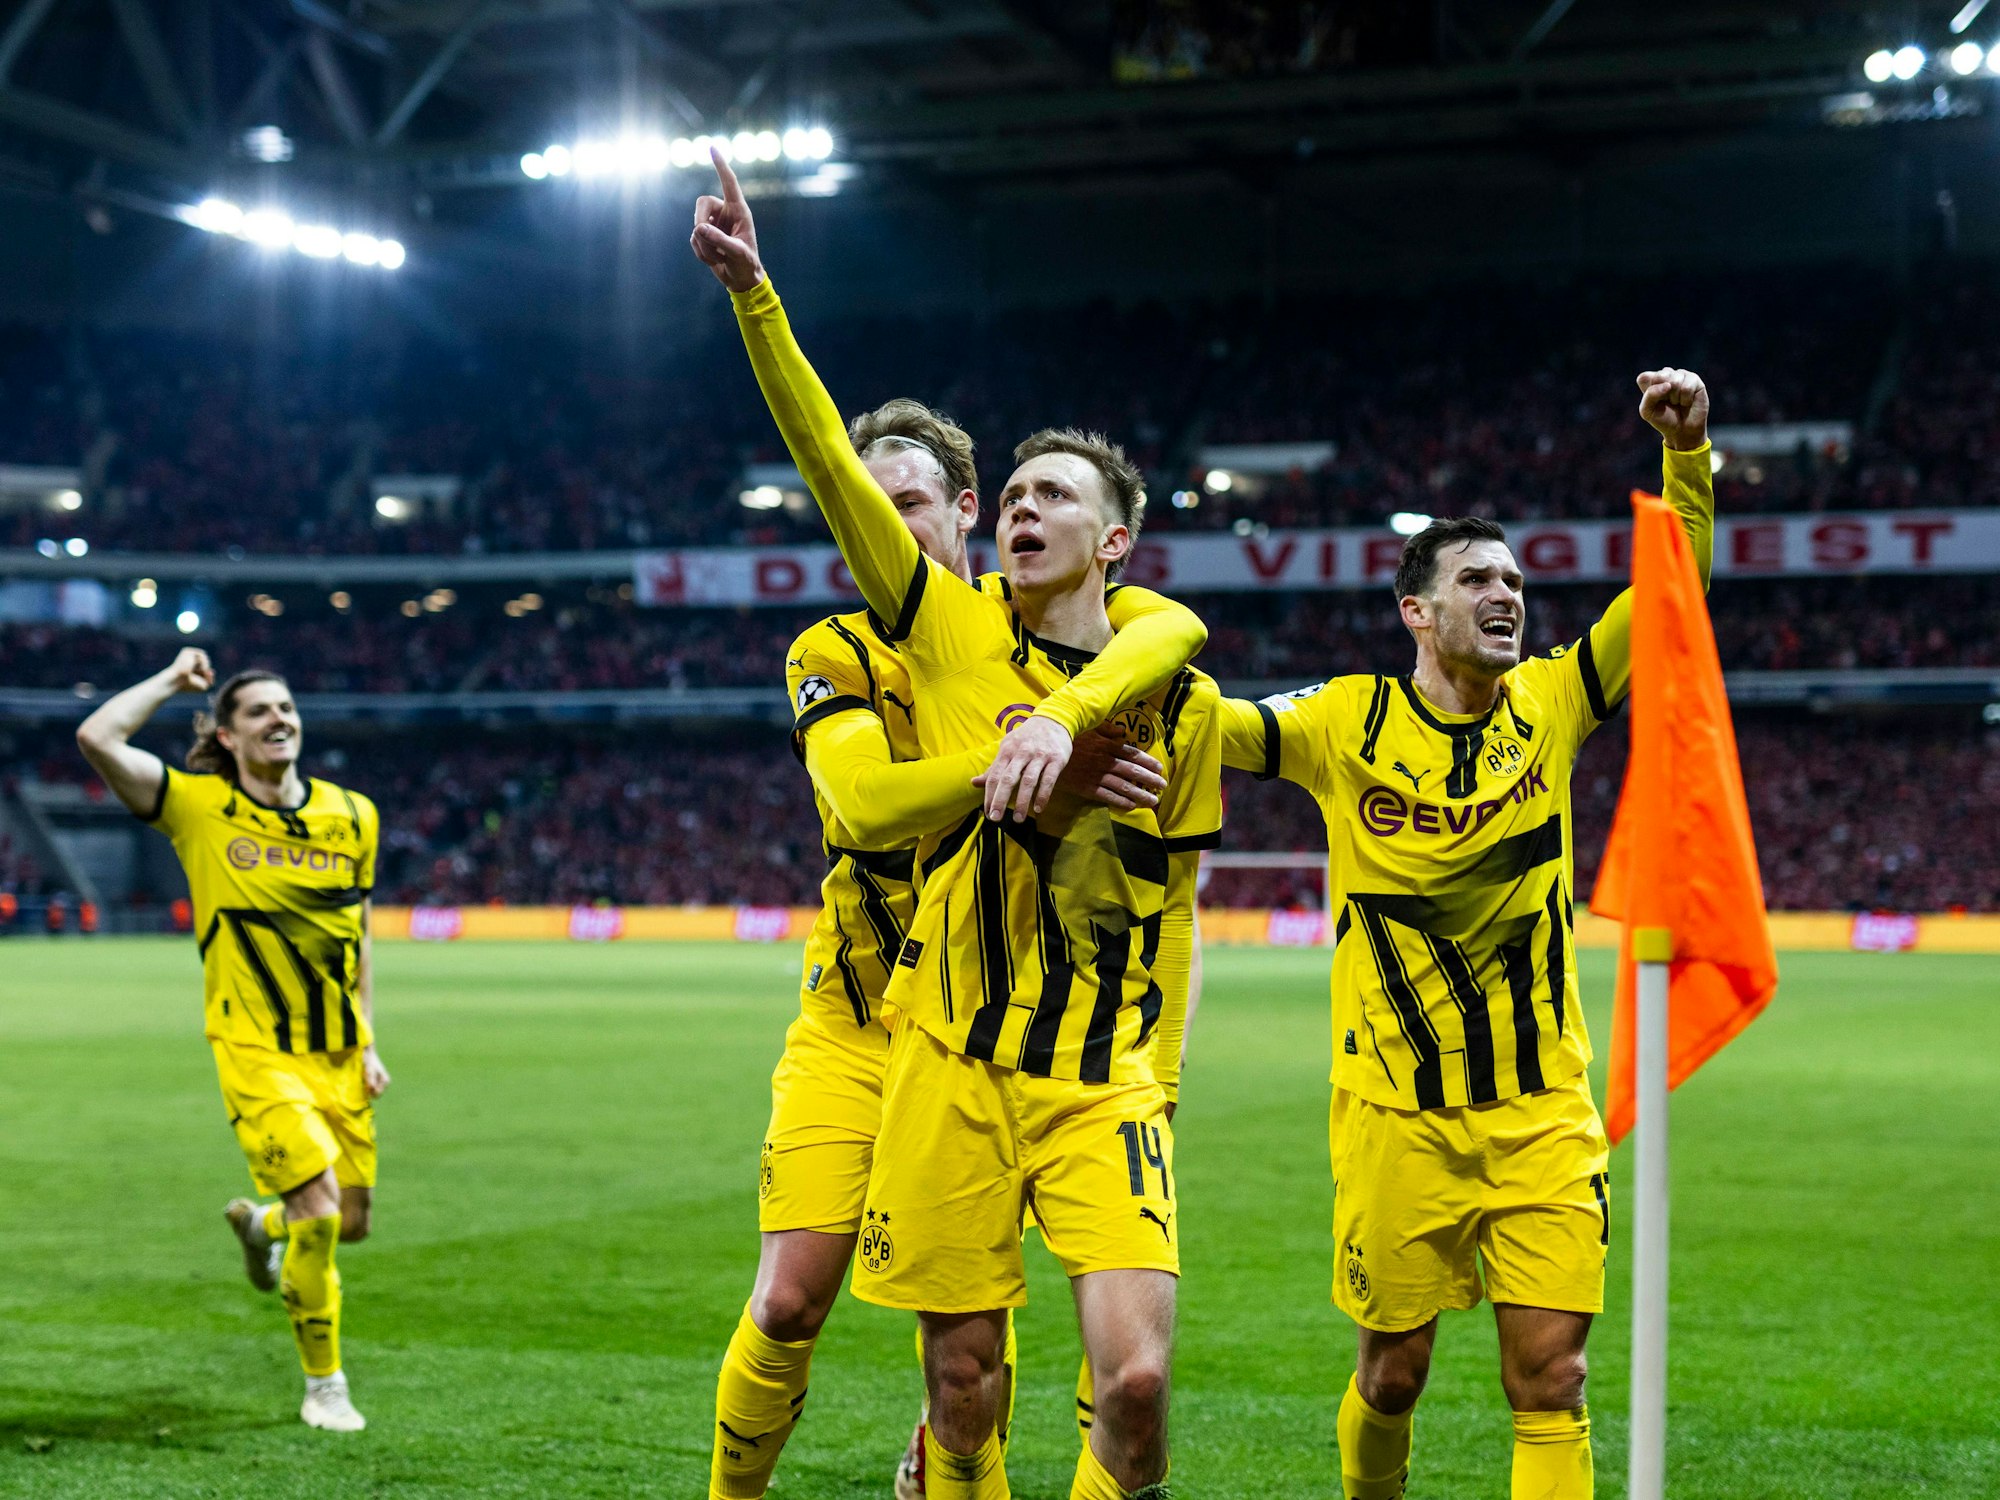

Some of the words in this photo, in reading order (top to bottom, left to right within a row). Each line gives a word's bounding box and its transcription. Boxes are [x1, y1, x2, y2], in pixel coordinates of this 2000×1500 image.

[1731, 520, 1954, 570] EST
[1487, 741, 1521, 771] BVB
[1116, 1121, 1169, 1201] 14
[863, 1229, 890, 1261] BVB
[869, 1257, 880, 1269] 09
[1349, 1262, 1367, 1291] BVB
